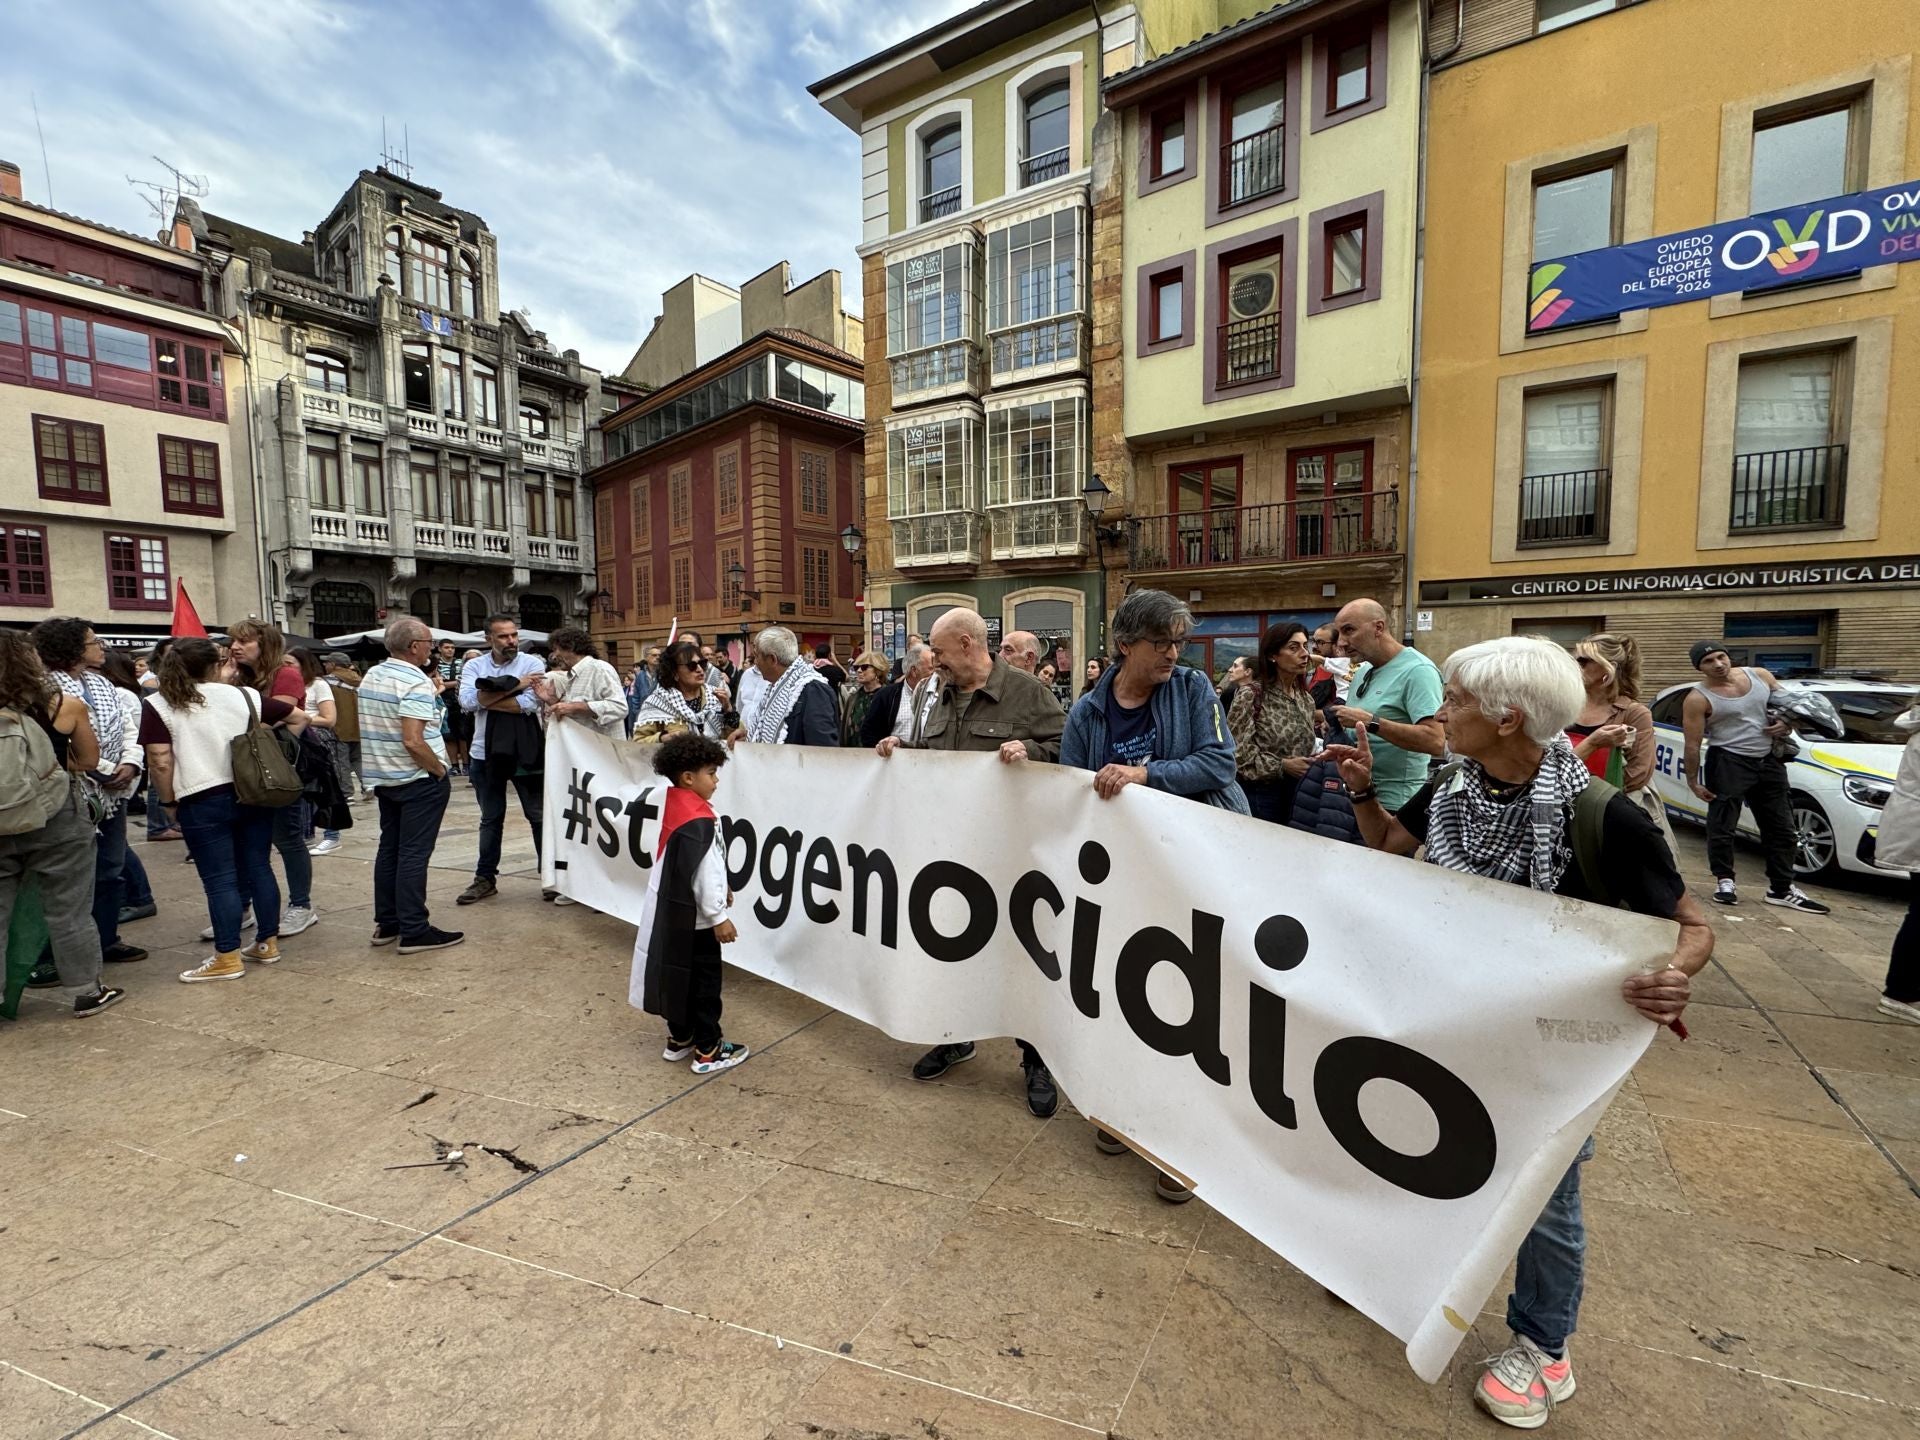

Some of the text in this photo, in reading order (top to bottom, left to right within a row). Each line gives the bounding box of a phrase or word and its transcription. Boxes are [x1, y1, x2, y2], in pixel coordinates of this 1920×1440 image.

[1657, 234, 1714, 254] OVIEDO
[1722, 209, 1871, 276] OVD
[926, 254, 941, 263] LOFT
[1657, 245, 1713, 265] CIUDAD
[908, 268, 923, 278] creo
[926, 261, 940, 269] CITY
[926, 267, 940, 275] HALL
[1648, 257, 1712, 278] EUROPEA
[1622, 267, 1712, 294] DEL DEPORTE
[1675, 278, 1711, 294] 2026
[926, 424, 941, 432] LOFT
[1511, 579, 1581, 595] CENTRO
[1585, 578, 1609, 592] DE
[1613, 570, 1755, 591] INFORMACIÓN
[1759, 566, 1873, 584] TURÍSTICA
